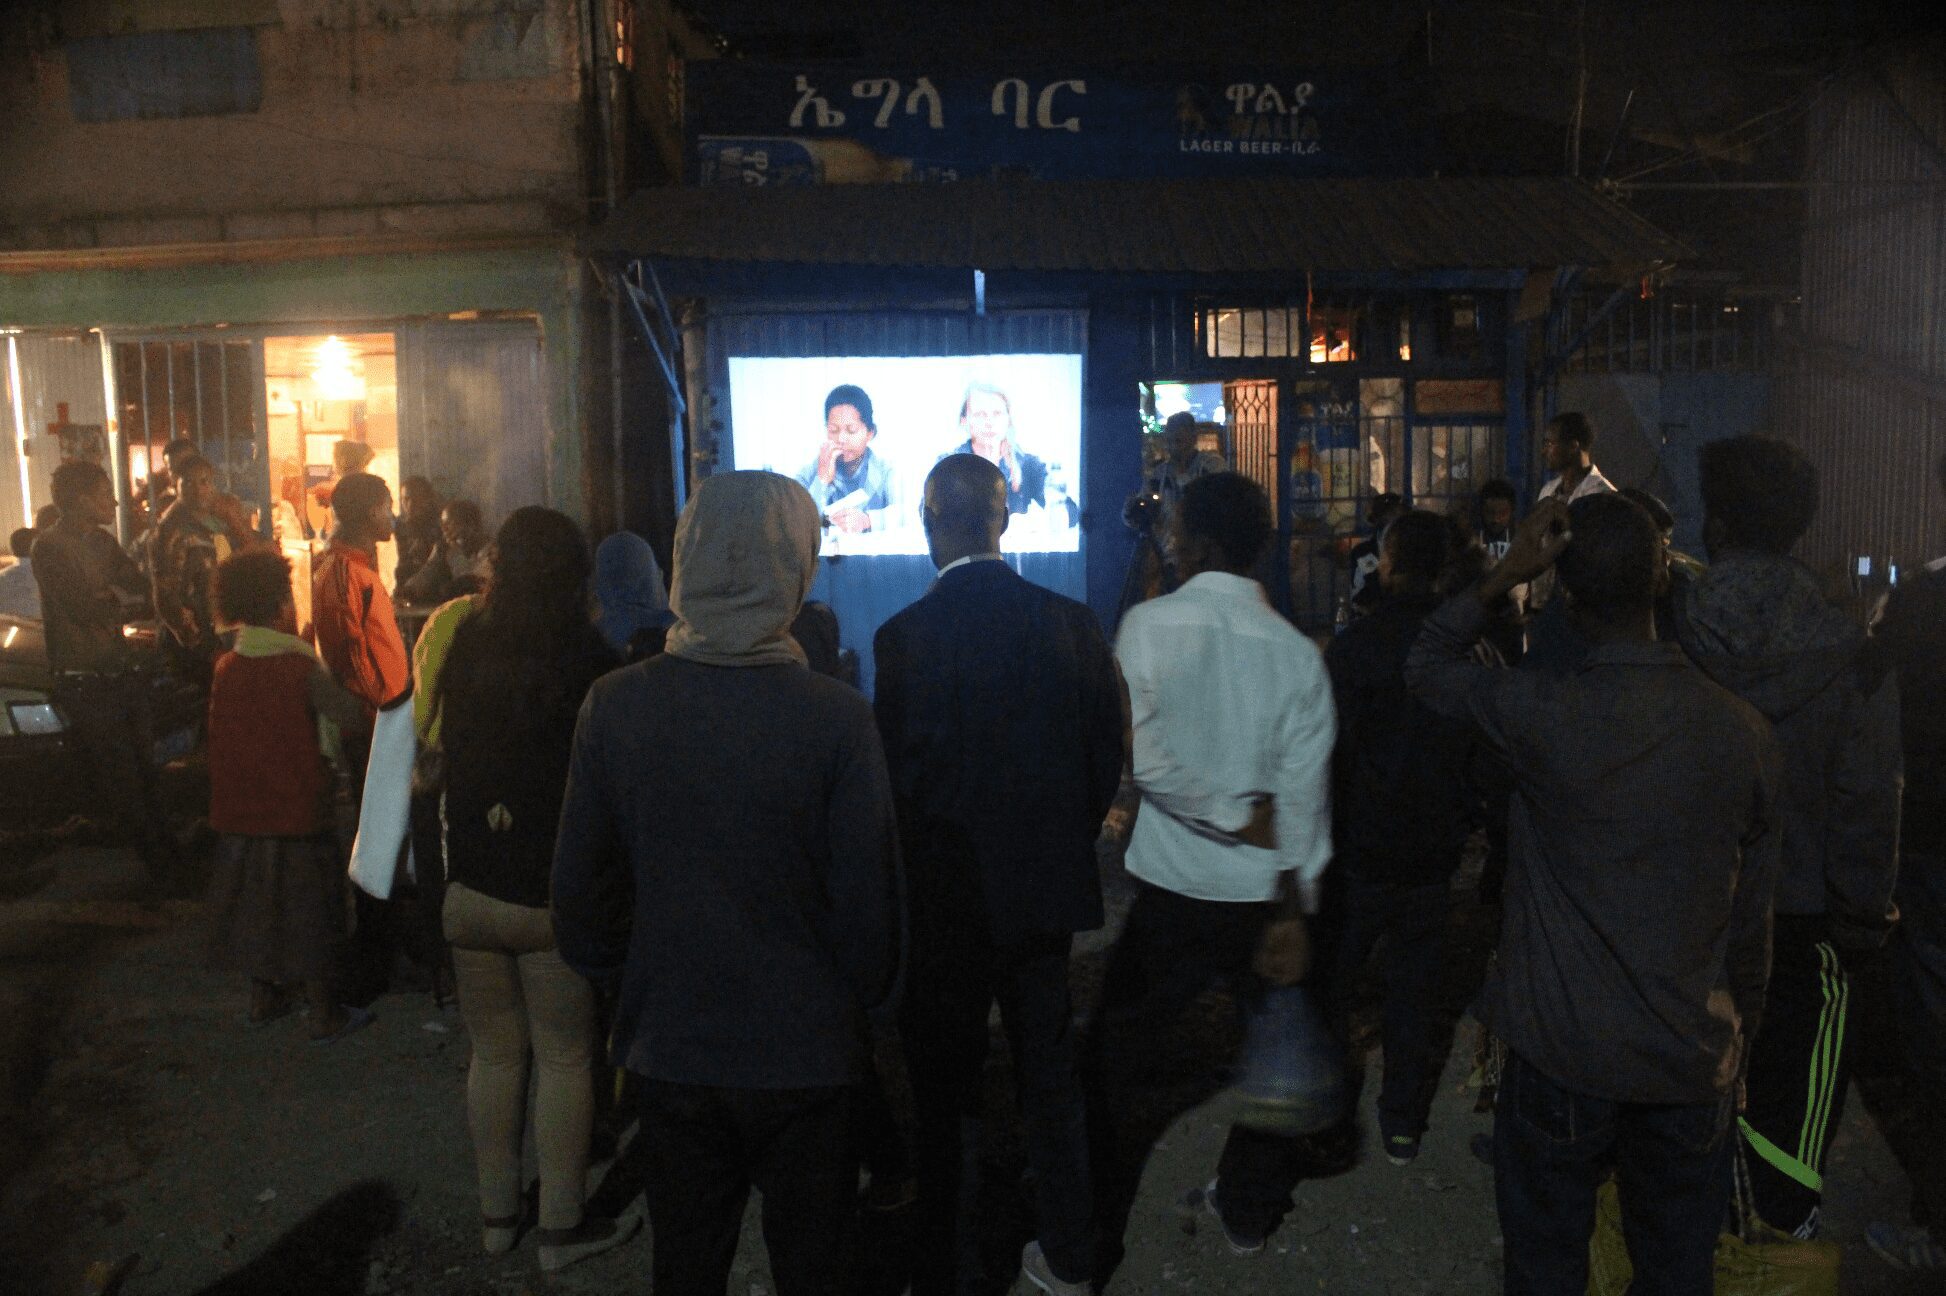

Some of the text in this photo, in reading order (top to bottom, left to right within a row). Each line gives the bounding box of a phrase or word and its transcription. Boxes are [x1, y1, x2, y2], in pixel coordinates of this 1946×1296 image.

[991, 77, 1087, 133] ባር
[1225, 81, 1315, 114] ዋልያ
[1179, 138, 1234, 153] LAGER
